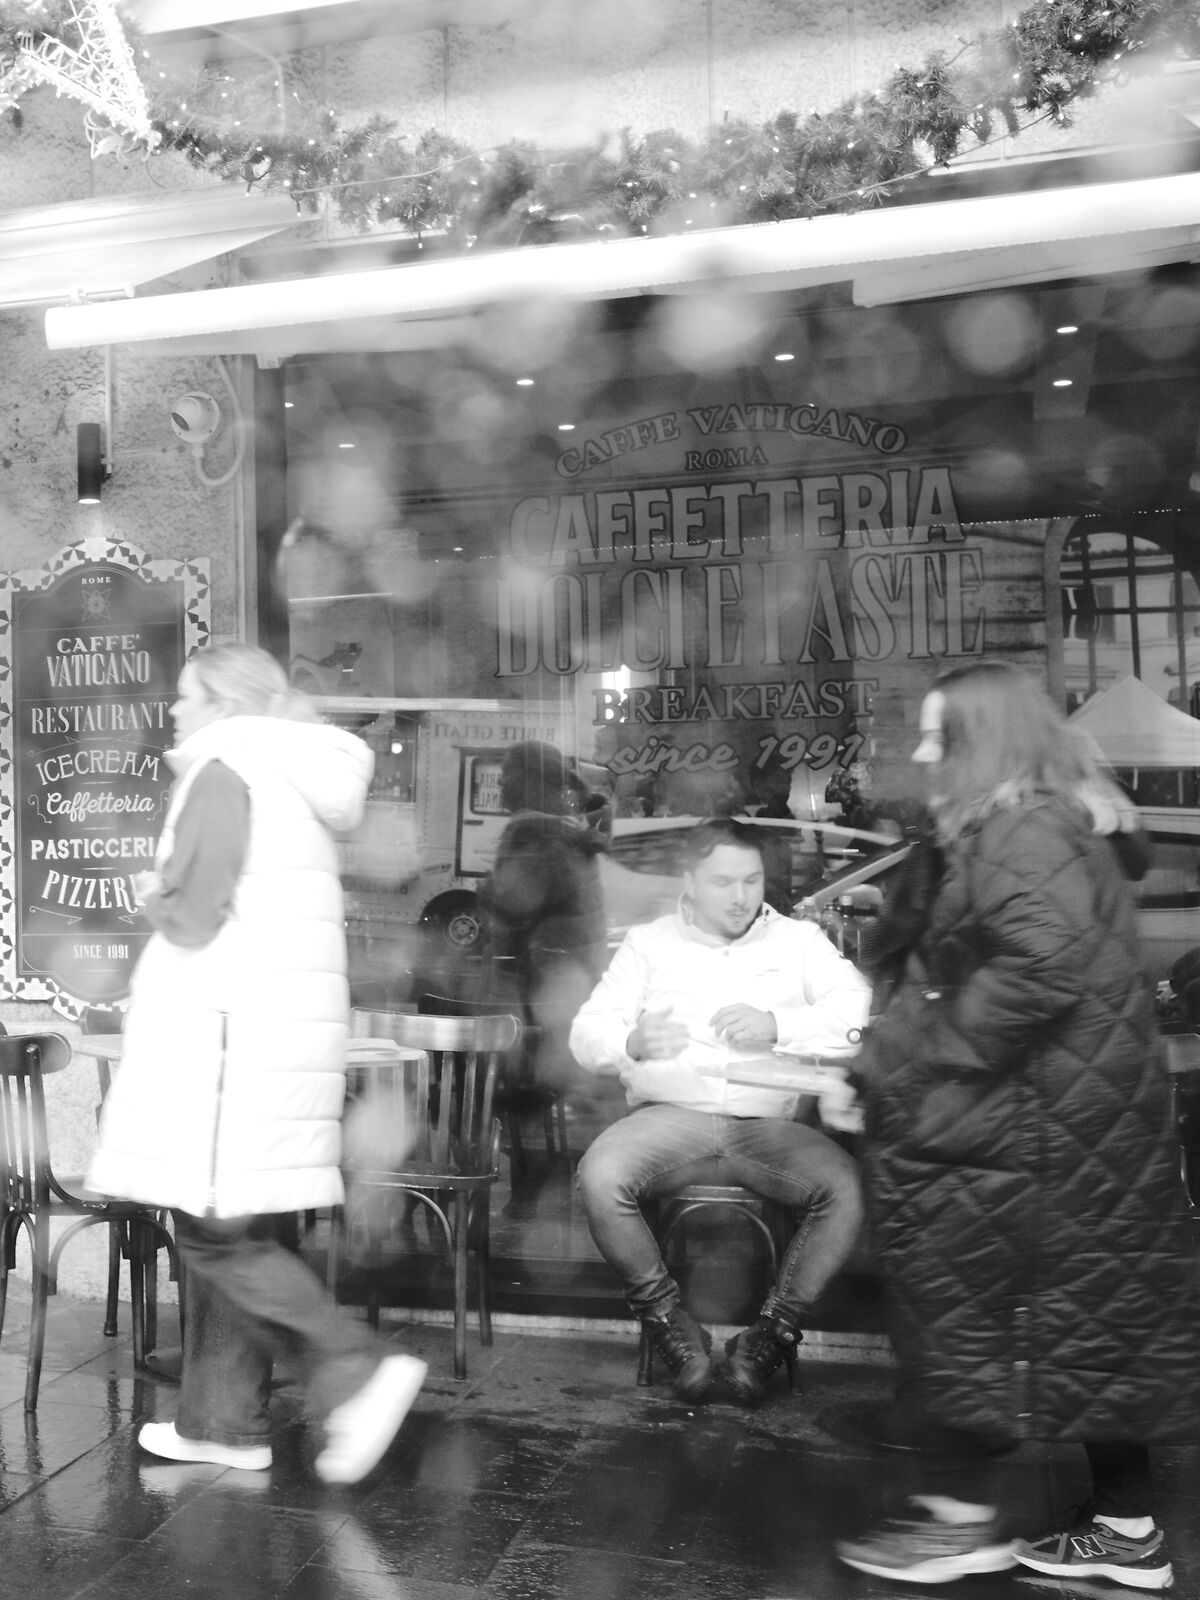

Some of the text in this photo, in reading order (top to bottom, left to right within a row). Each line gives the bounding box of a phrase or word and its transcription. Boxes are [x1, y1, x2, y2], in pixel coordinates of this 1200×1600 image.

[555, 402, 907, 479] CAFFE VATICANO
[685, 445, 769, 471] ROMA
[508, 466, 967, 567] CAFFETTERIA
[81, 576, 111, 585] ROME
[494, 565, 690, 677] DOLCI
[758, 547, 986, 666] PASTE
[46, 650, 150, 688] VATICANO
[30, 701, 168, 735] RESTAURANT
[591, 678, 880, 726] BREAKFAST
[35, 749, 161, 786] ICECREAM
[606, 731, 866, 775] since 1991
[46, 791, 155, 823] Caffetteria
[73, 944, 129, 960] SINCE 1991
[1071, 1534, 1107, 1559] N
